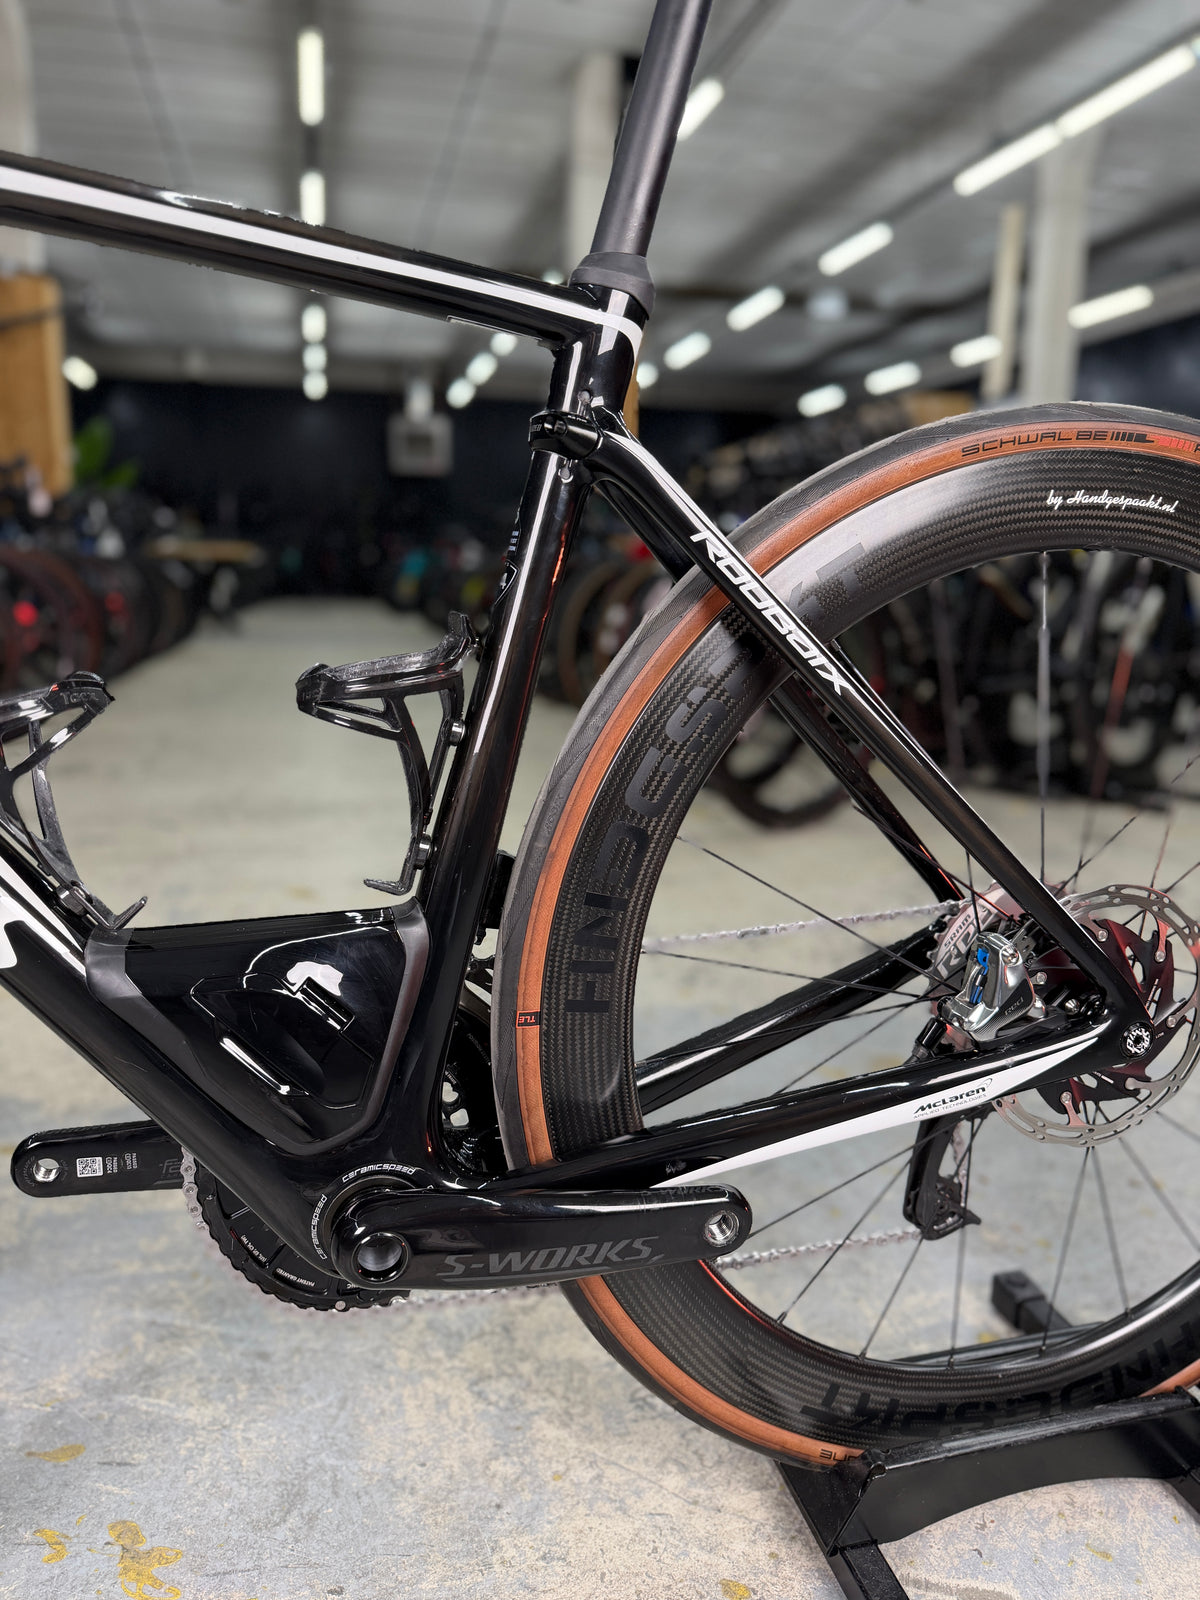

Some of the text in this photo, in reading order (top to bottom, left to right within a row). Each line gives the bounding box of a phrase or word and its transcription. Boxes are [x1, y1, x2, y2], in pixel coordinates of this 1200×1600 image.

[961, 430, 1109, 457] SCHWALBE
[1046, 489, 1179, 513] by Handgespaakt.nl
[943, 912, 972, 949] SRAM
[913, 1085, 987, 1114] McLaren
[342, 1163, 417, 1182] ceramicspeed
[311, 1193, 328, 1260] ceramicspeed
[436, 1236, 661, 1277] S-WORKS
